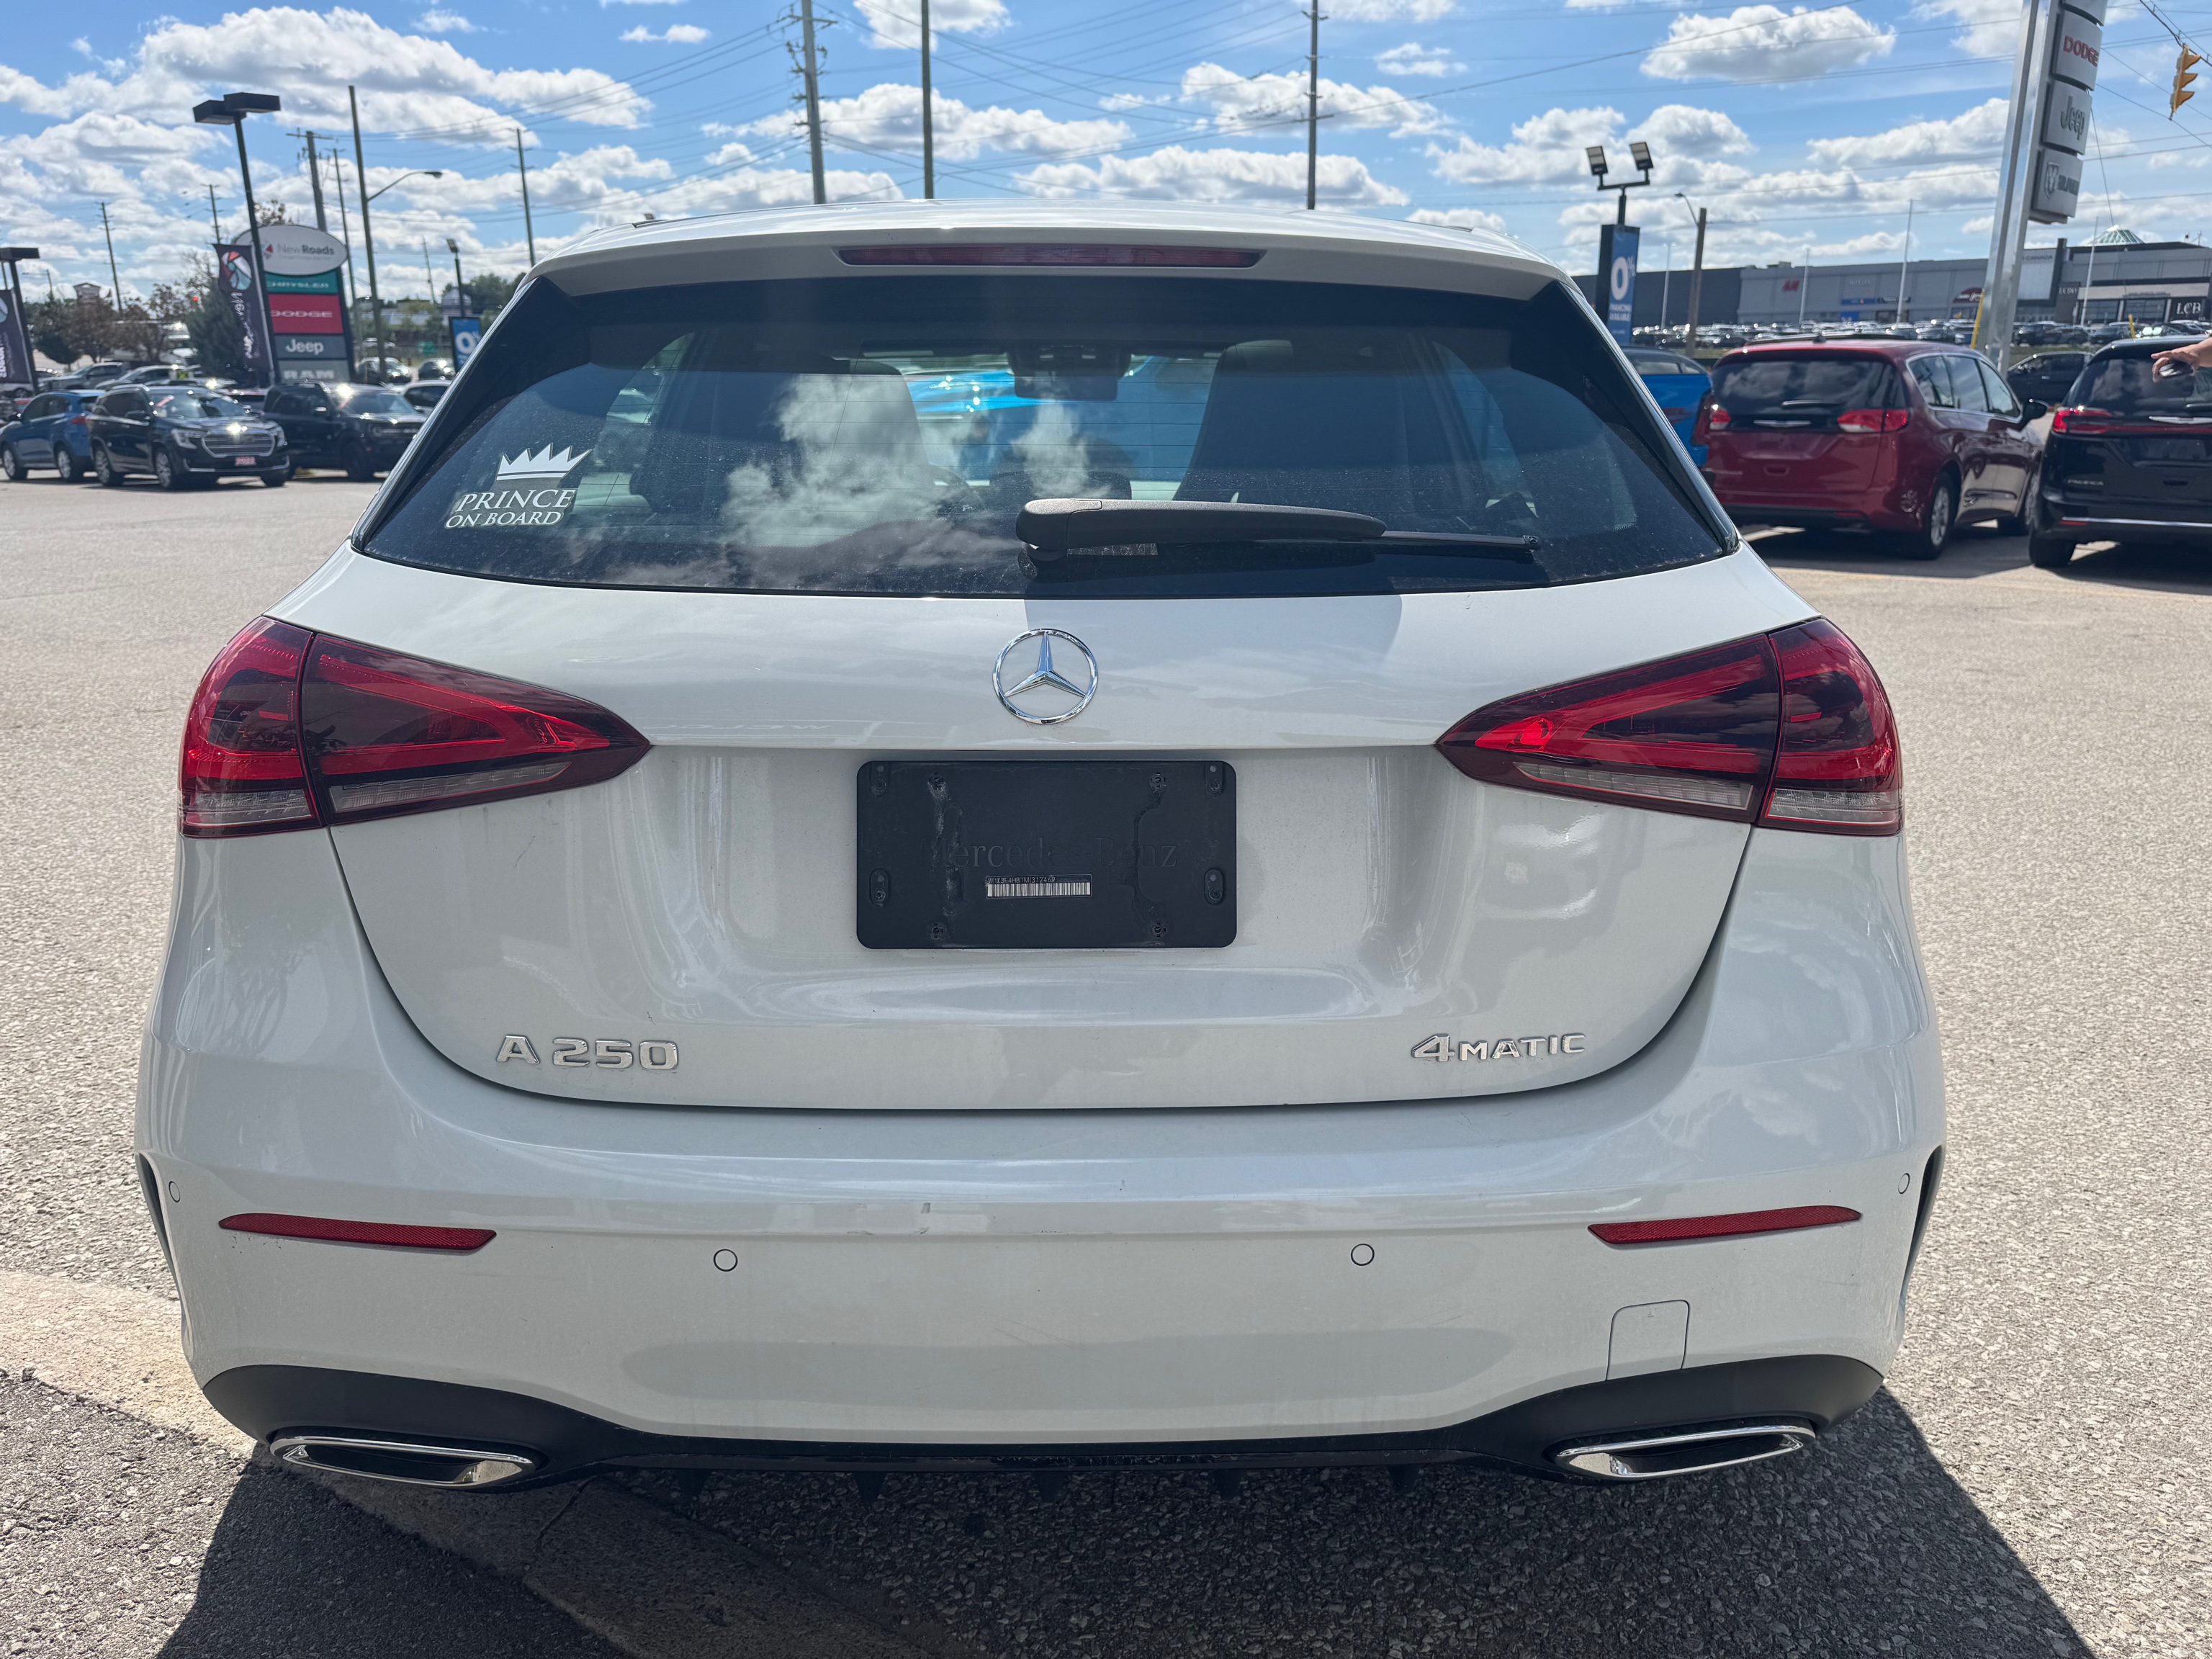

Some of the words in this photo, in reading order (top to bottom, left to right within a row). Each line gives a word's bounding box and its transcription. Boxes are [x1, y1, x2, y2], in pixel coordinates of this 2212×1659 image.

[2063, 35, 2099, 68] DODGE
[2060, 96, 2085, 140] Jeep
[286, 338, 323, 355] Jeep
[284, 370, 334, 379] RAM
[454, 489, 576, 512] PRINCE
[446, 513, 481, 528] ON
[482, 511, 562, 526] BOARD
[496, 1034, 539, 1064] A
[552, 1038, 679, 1070] 250
[1411, 1033, 1586, 1062] 4MATIC
